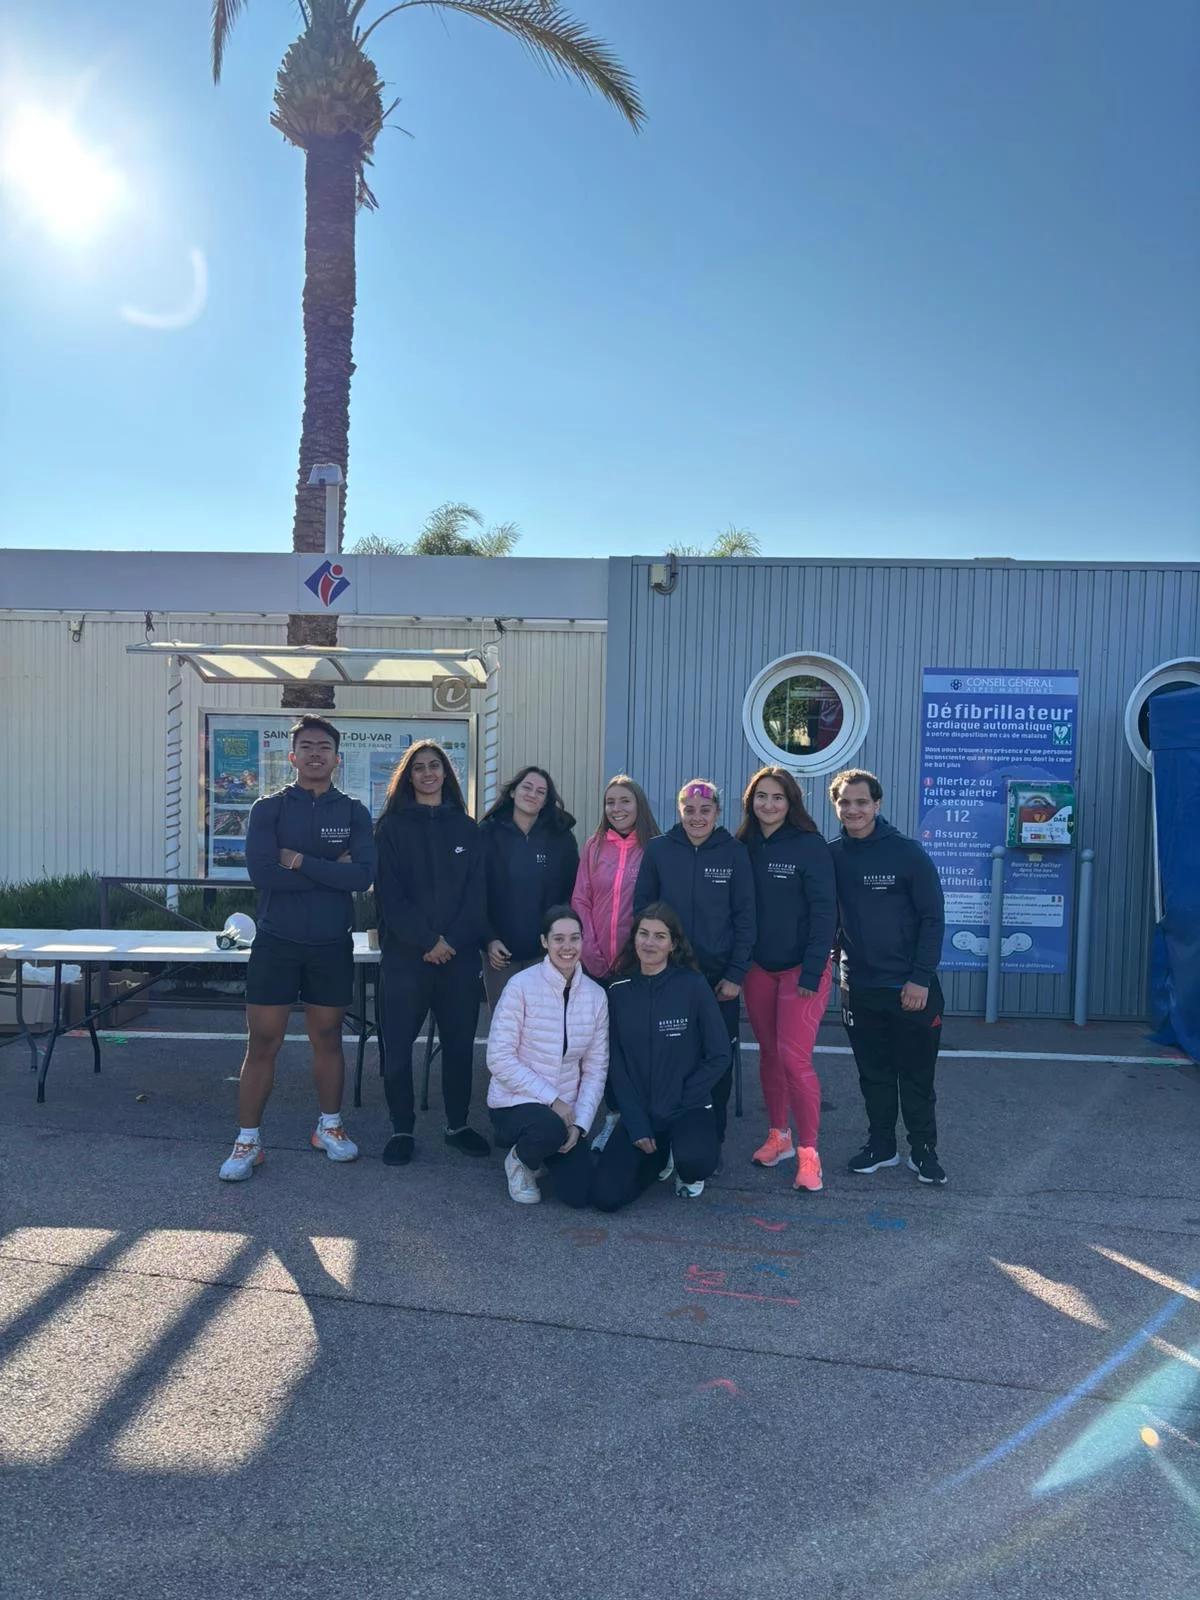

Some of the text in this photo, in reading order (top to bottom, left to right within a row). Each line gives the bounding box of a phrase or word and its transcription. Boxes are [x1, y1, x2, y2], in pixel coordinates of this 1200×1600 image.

[966, 678, 1007, 687] CONSEIL
[927, 702, 1073, 721] Défibrillateur
[926, 721, 1052, 731] cardiaque automatique
[936, 777, 976, 786] Alertez
[924, 787, 998, 797] faites alerter
[923, 797, 939, 806] les
[945, 810, 970, 822] 112
[935, 830, 978, 839] Assurez
[940, 877, 992, 886] éfibrillat
